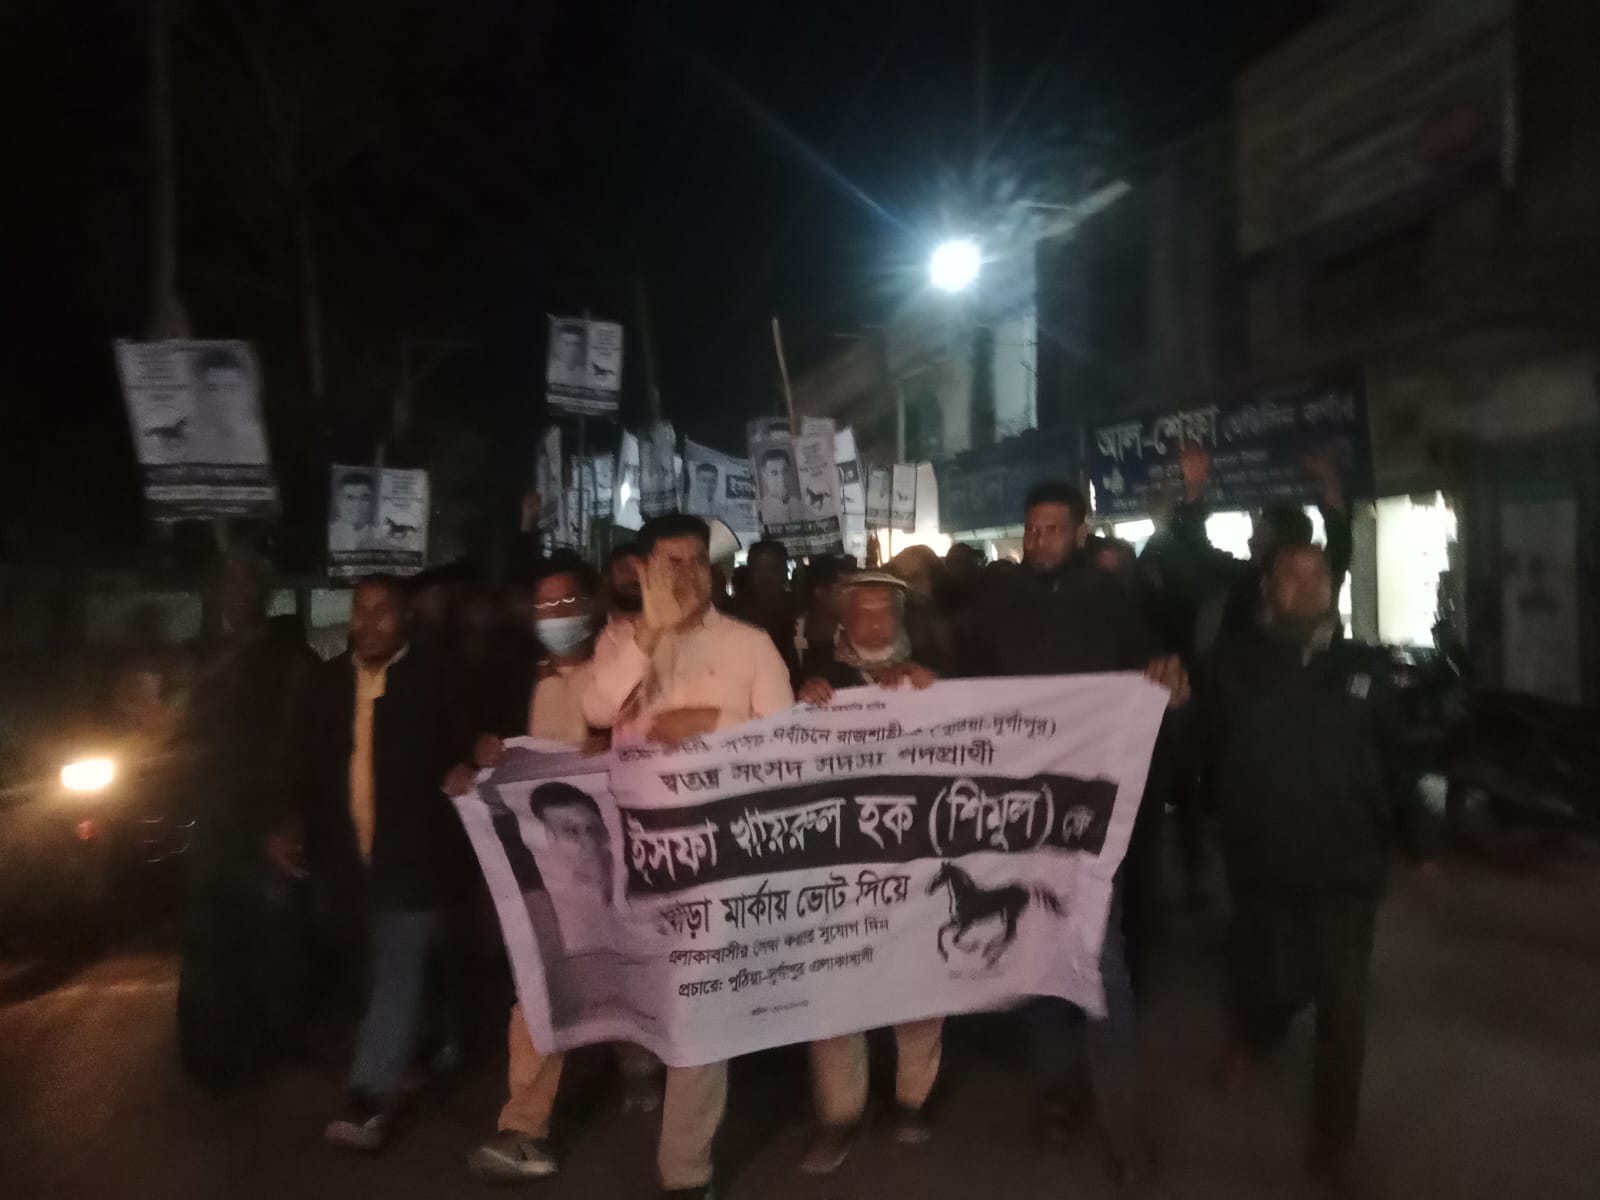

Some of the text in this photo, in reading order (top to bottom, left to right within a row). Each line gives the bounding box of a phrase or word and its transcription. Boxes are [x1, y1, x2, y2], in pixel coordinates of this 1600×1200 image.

[626, 812, 719, 886] ইসফা
[730, 797, 847, 858] খায়রুল
[854, 795, 917, 849] হক
[720, 880, 791, 928] মার্কায়
[797, 872, 849, 919] ভোট
[856, 870, 911, 906] দিয়ে
